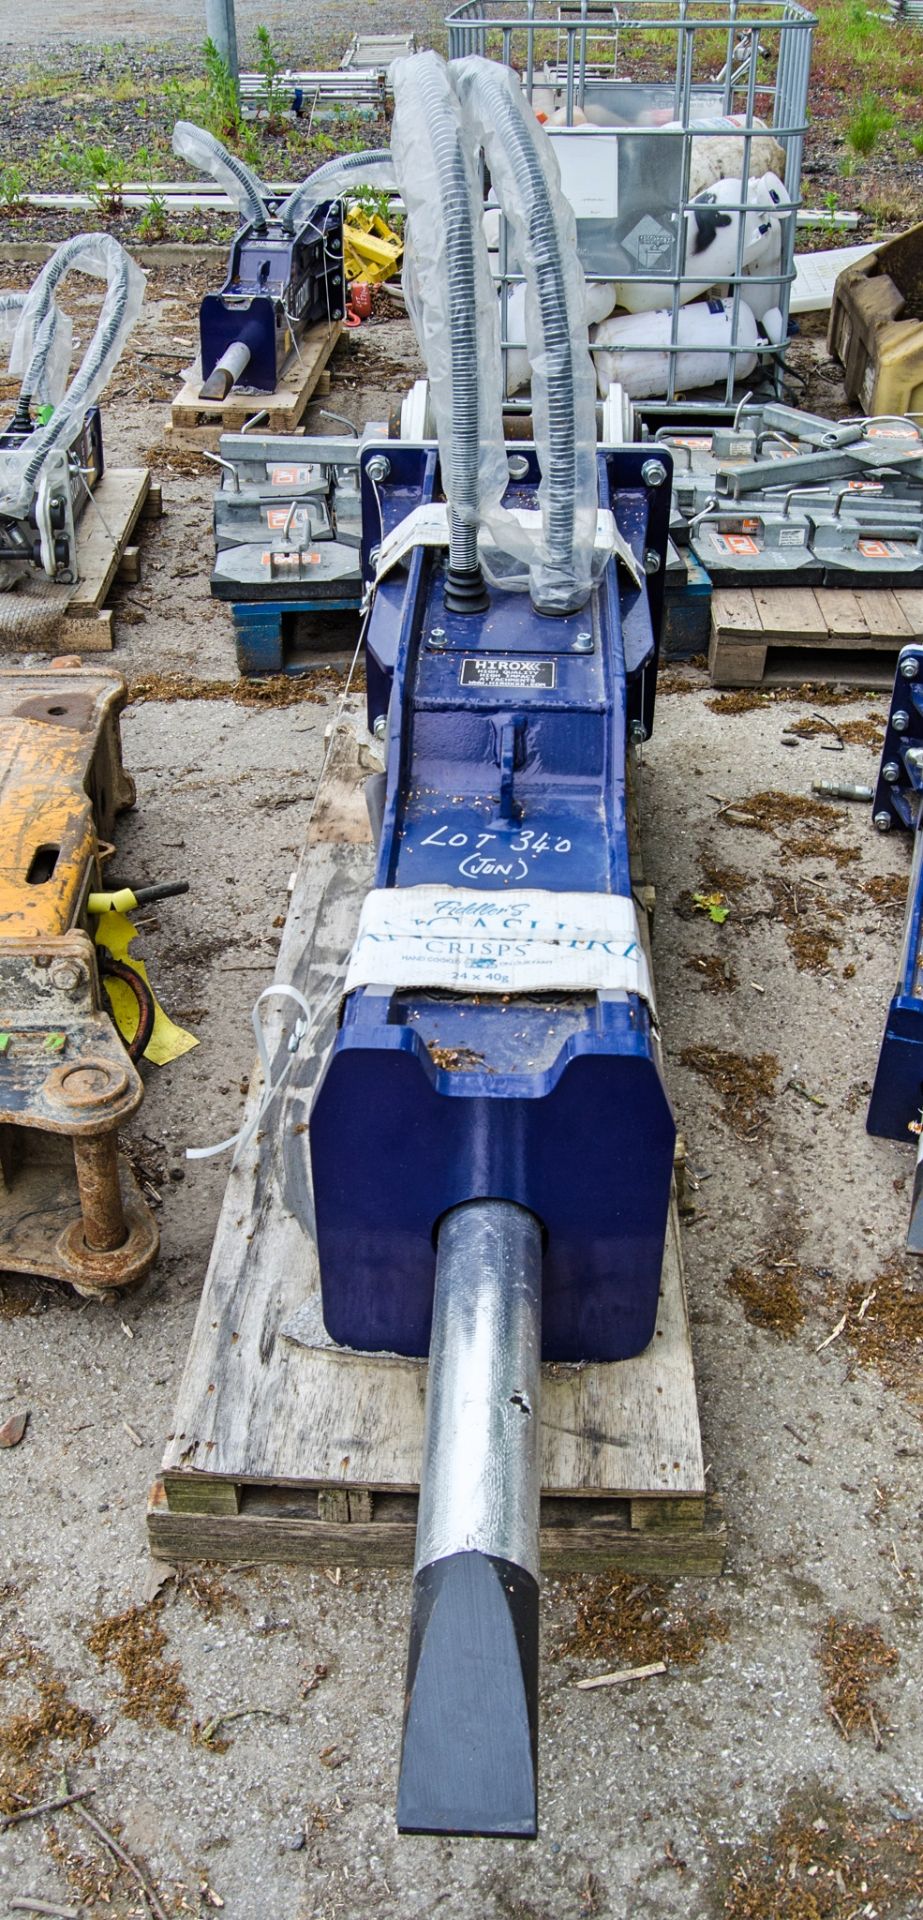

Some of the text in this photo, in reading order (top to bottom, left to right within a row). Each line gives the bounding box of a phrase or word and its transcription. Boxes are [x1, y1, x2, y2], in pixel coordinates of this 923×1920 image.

[420, 825, 571, 853] LOT 340
[425, 940, 528, 957] CRISPS
[451, 971, 468, 980] 24
[485, 972, 509, 983] 40g
